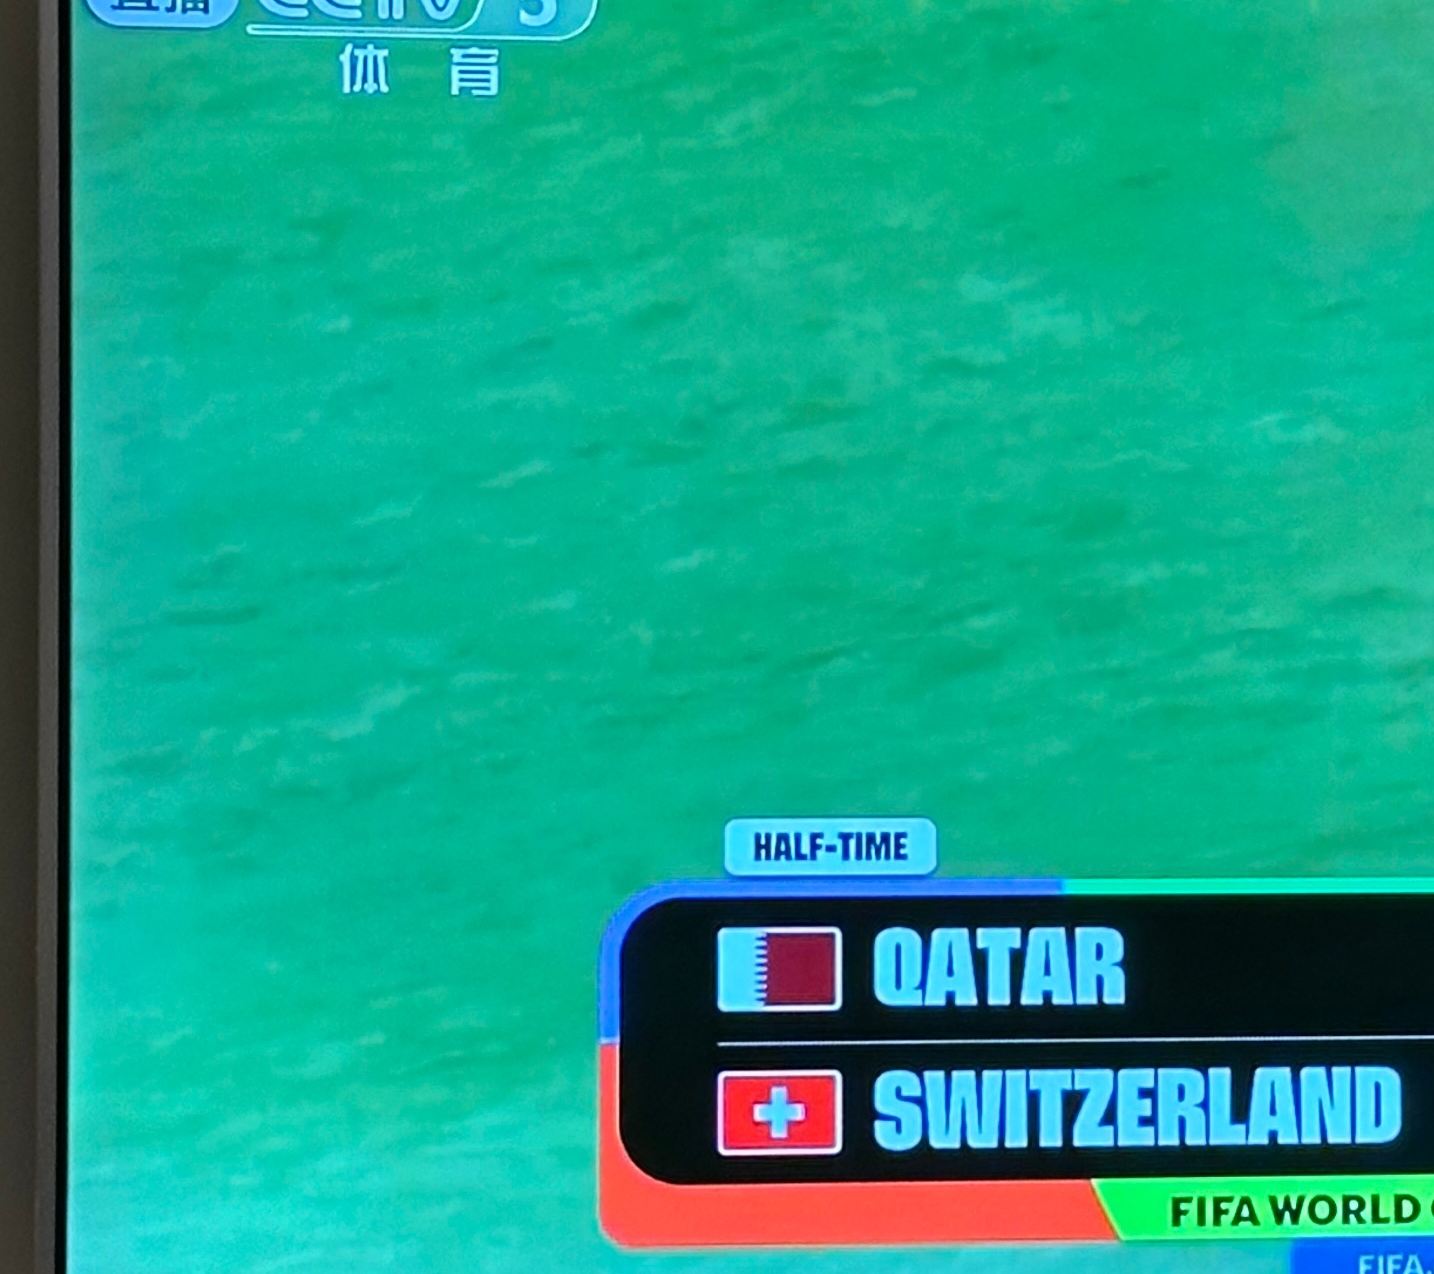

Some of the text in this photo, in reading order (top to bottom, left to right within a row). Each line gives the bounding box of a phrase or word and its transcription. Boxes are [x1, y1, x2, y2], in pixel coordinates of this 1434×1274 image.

[339, 43, 499, 96] 体育
[753, 831, 909, 862] HALF-TIME
[873, 926, 1126, 1006] QATAR
[873, 1066, 1402, 1150] SWITZERLAND
[1170, 1195, 1261, 1227] FIFA
[1270, 1193, 1422, 1226] WORLD
